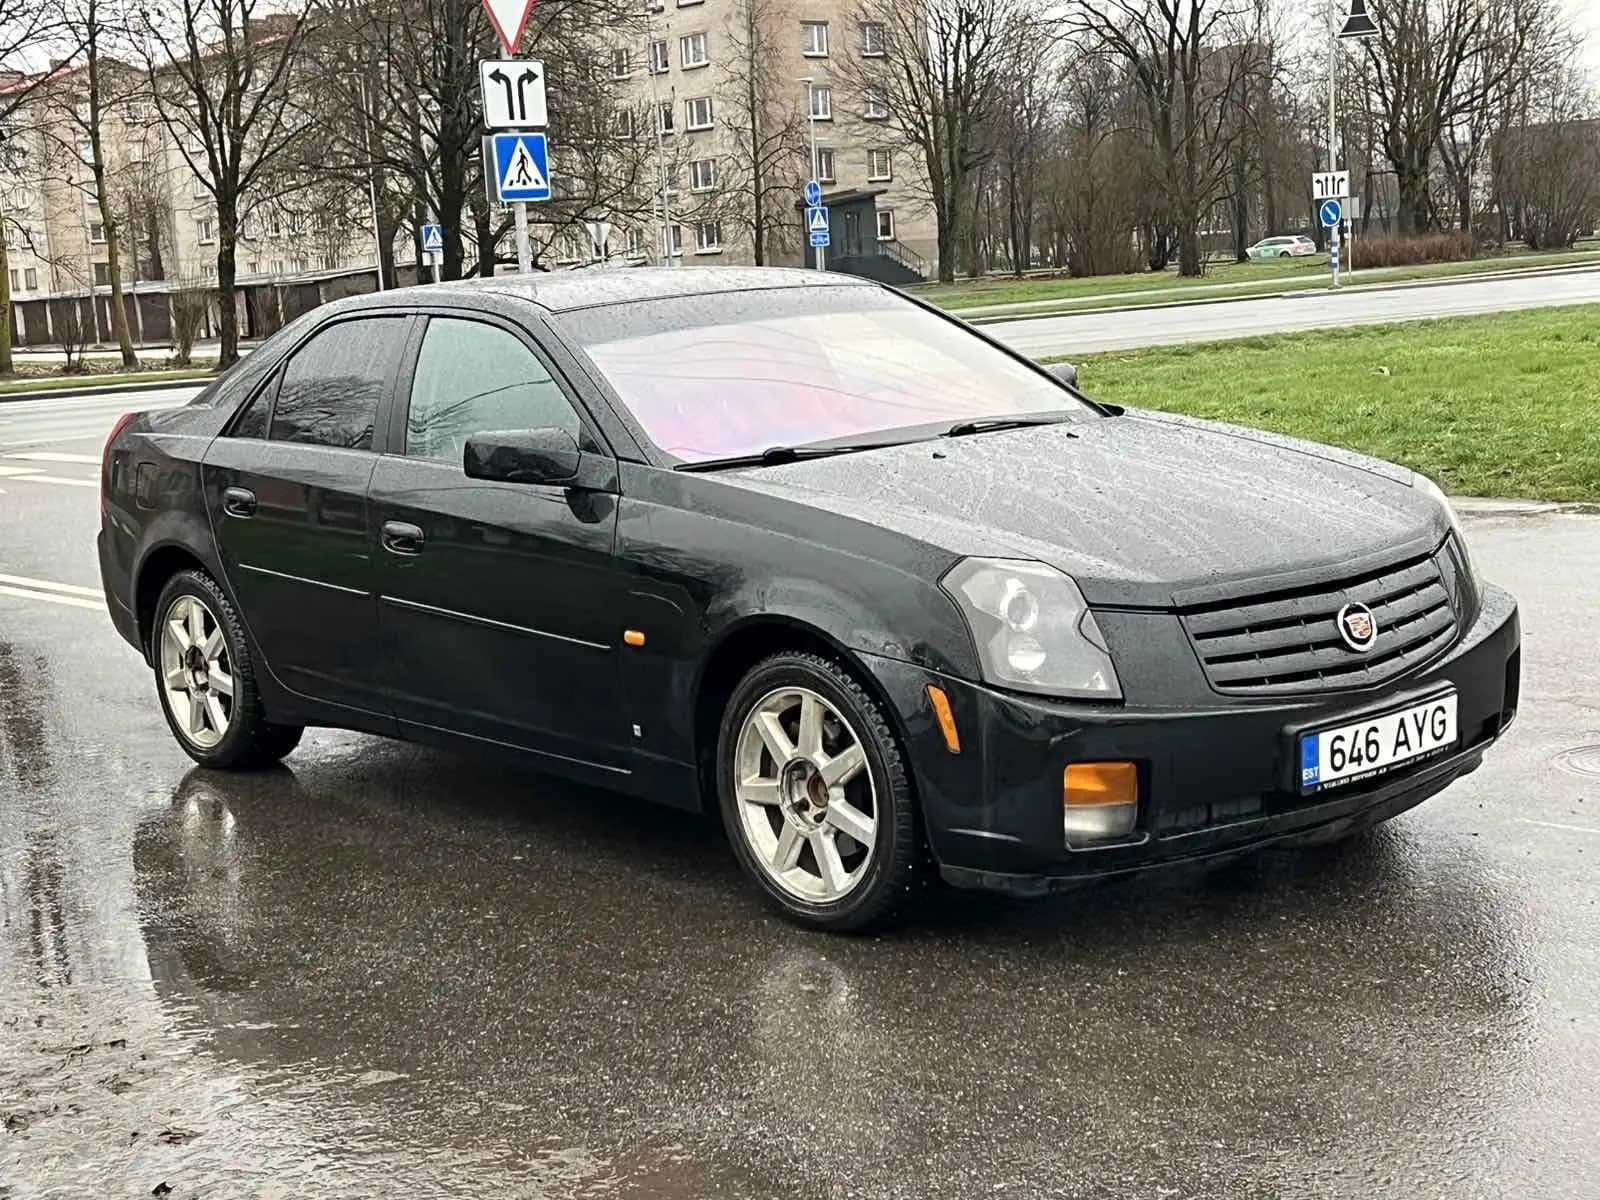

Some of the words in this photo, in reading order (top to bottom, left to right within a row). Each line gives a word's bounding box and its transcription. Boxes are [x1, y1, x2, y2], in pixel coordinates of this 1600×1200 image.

[1330, 726, 1380, 772] 646
[1393, 705, 1446, 757] AYG
[1302, 766, 1319, 780] EST
